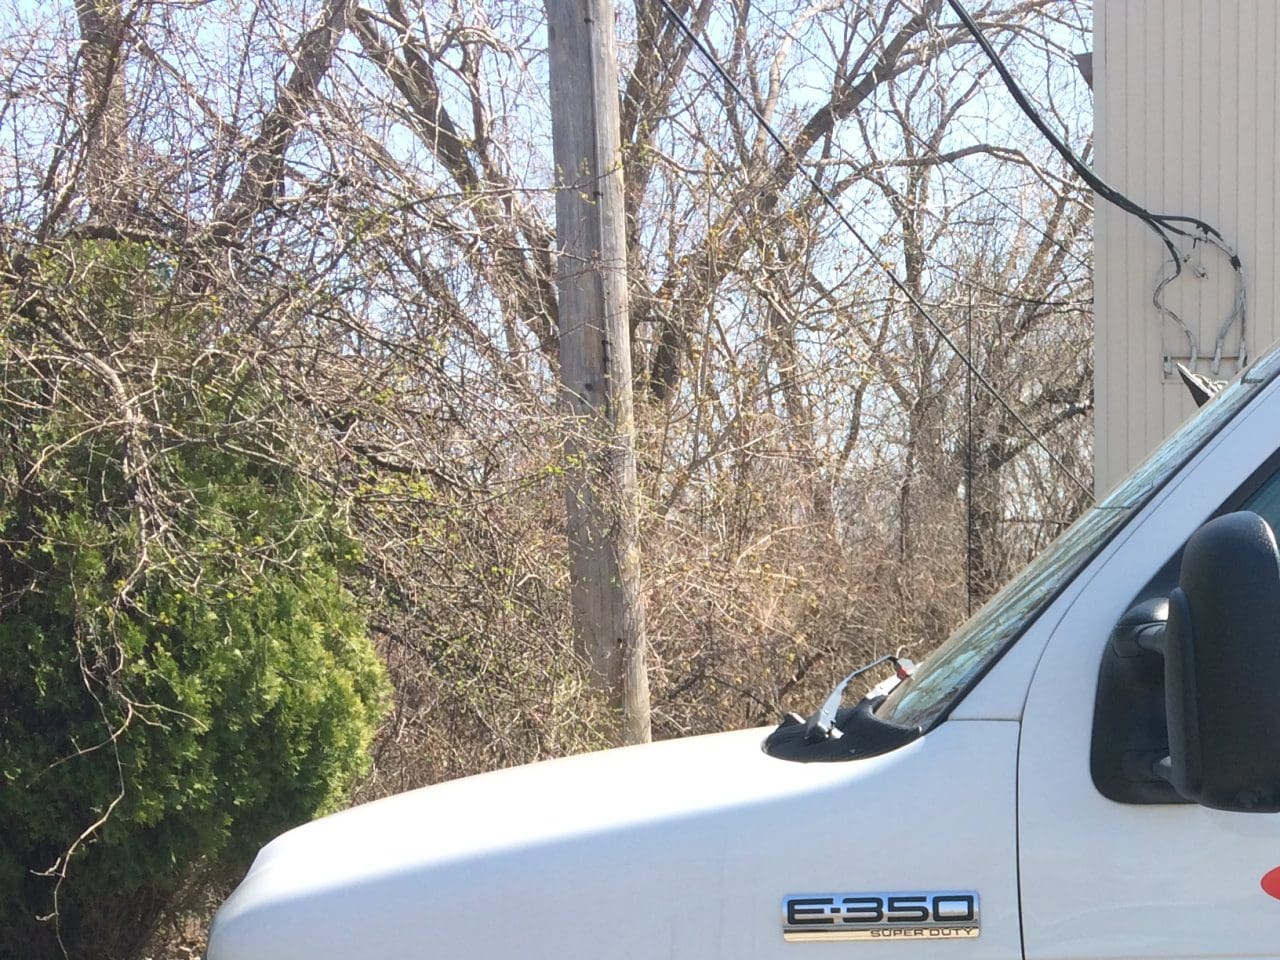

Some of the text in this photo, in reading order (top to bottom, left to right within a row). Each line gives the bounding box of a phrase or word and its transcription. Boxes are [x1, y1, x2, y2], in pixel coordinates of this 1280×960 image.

[787, 895, 974, 925] E-350
[870, 927, 974, 938] SUPER DUTY
